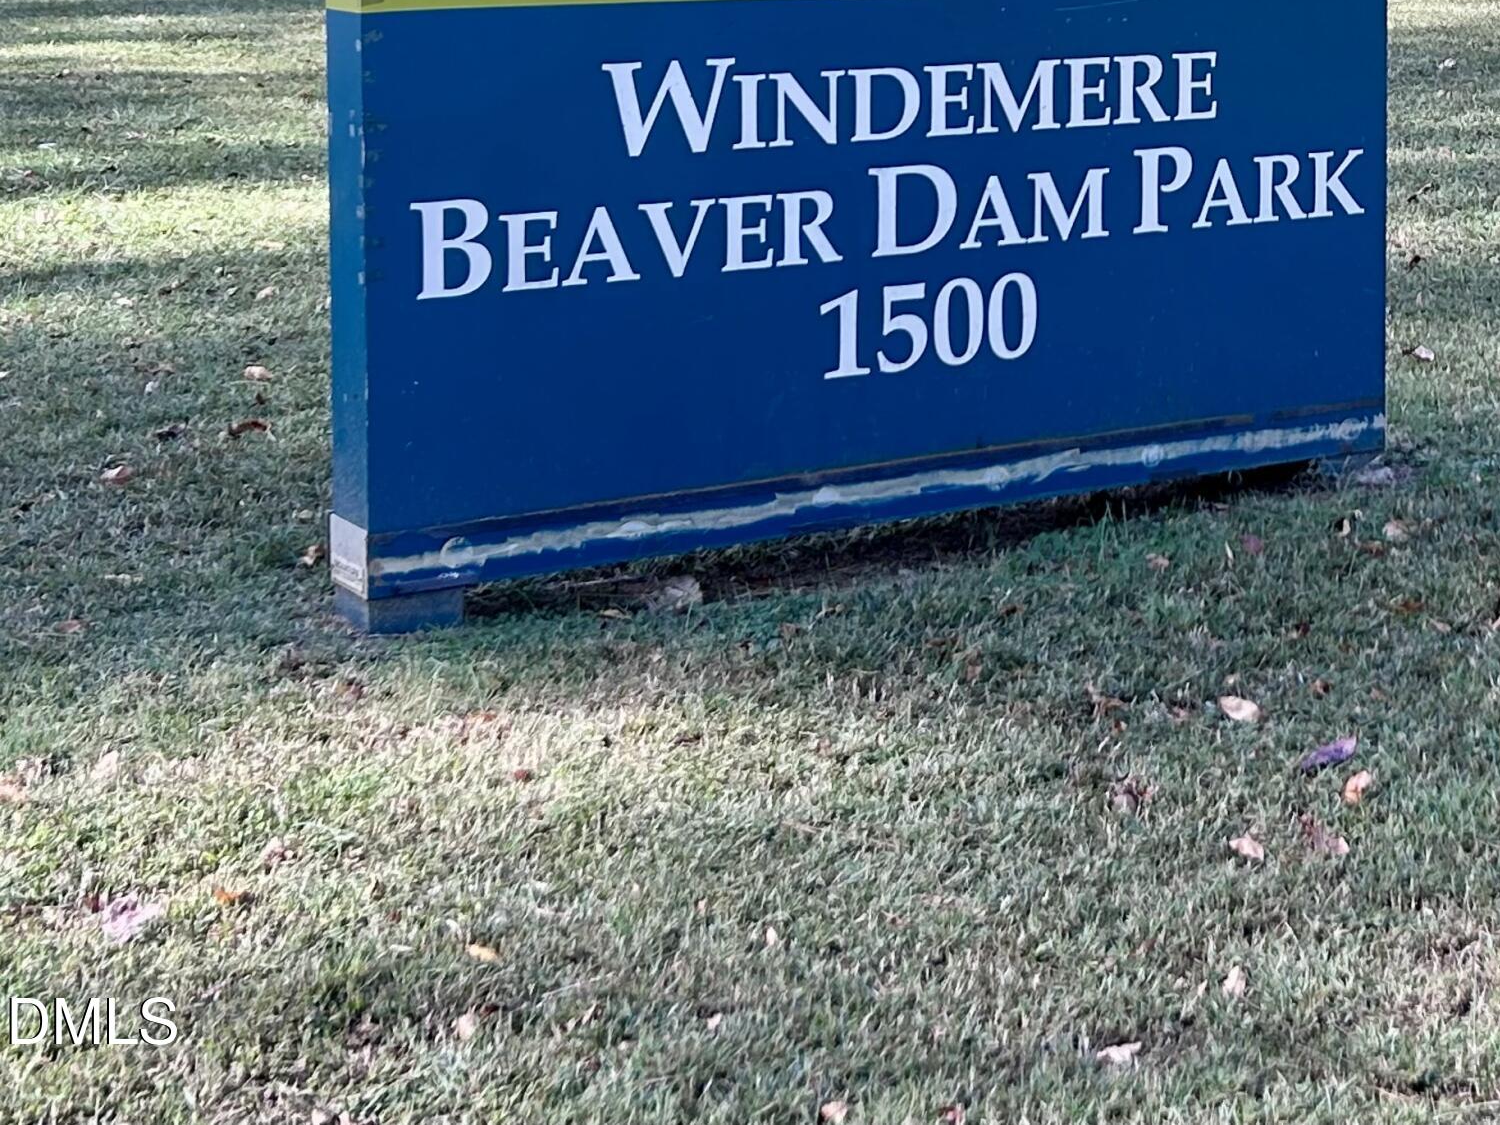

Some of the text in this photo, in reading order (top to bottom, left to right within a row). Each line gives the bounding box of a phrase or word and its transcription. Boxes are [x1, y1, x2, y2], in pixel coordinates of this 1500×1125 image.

[601, 50, 1219, 158] WINDEMERE
[409, 146, 1367, 301] BEAVER DAM PARK
[819, 271, 1038, 380] 1500
